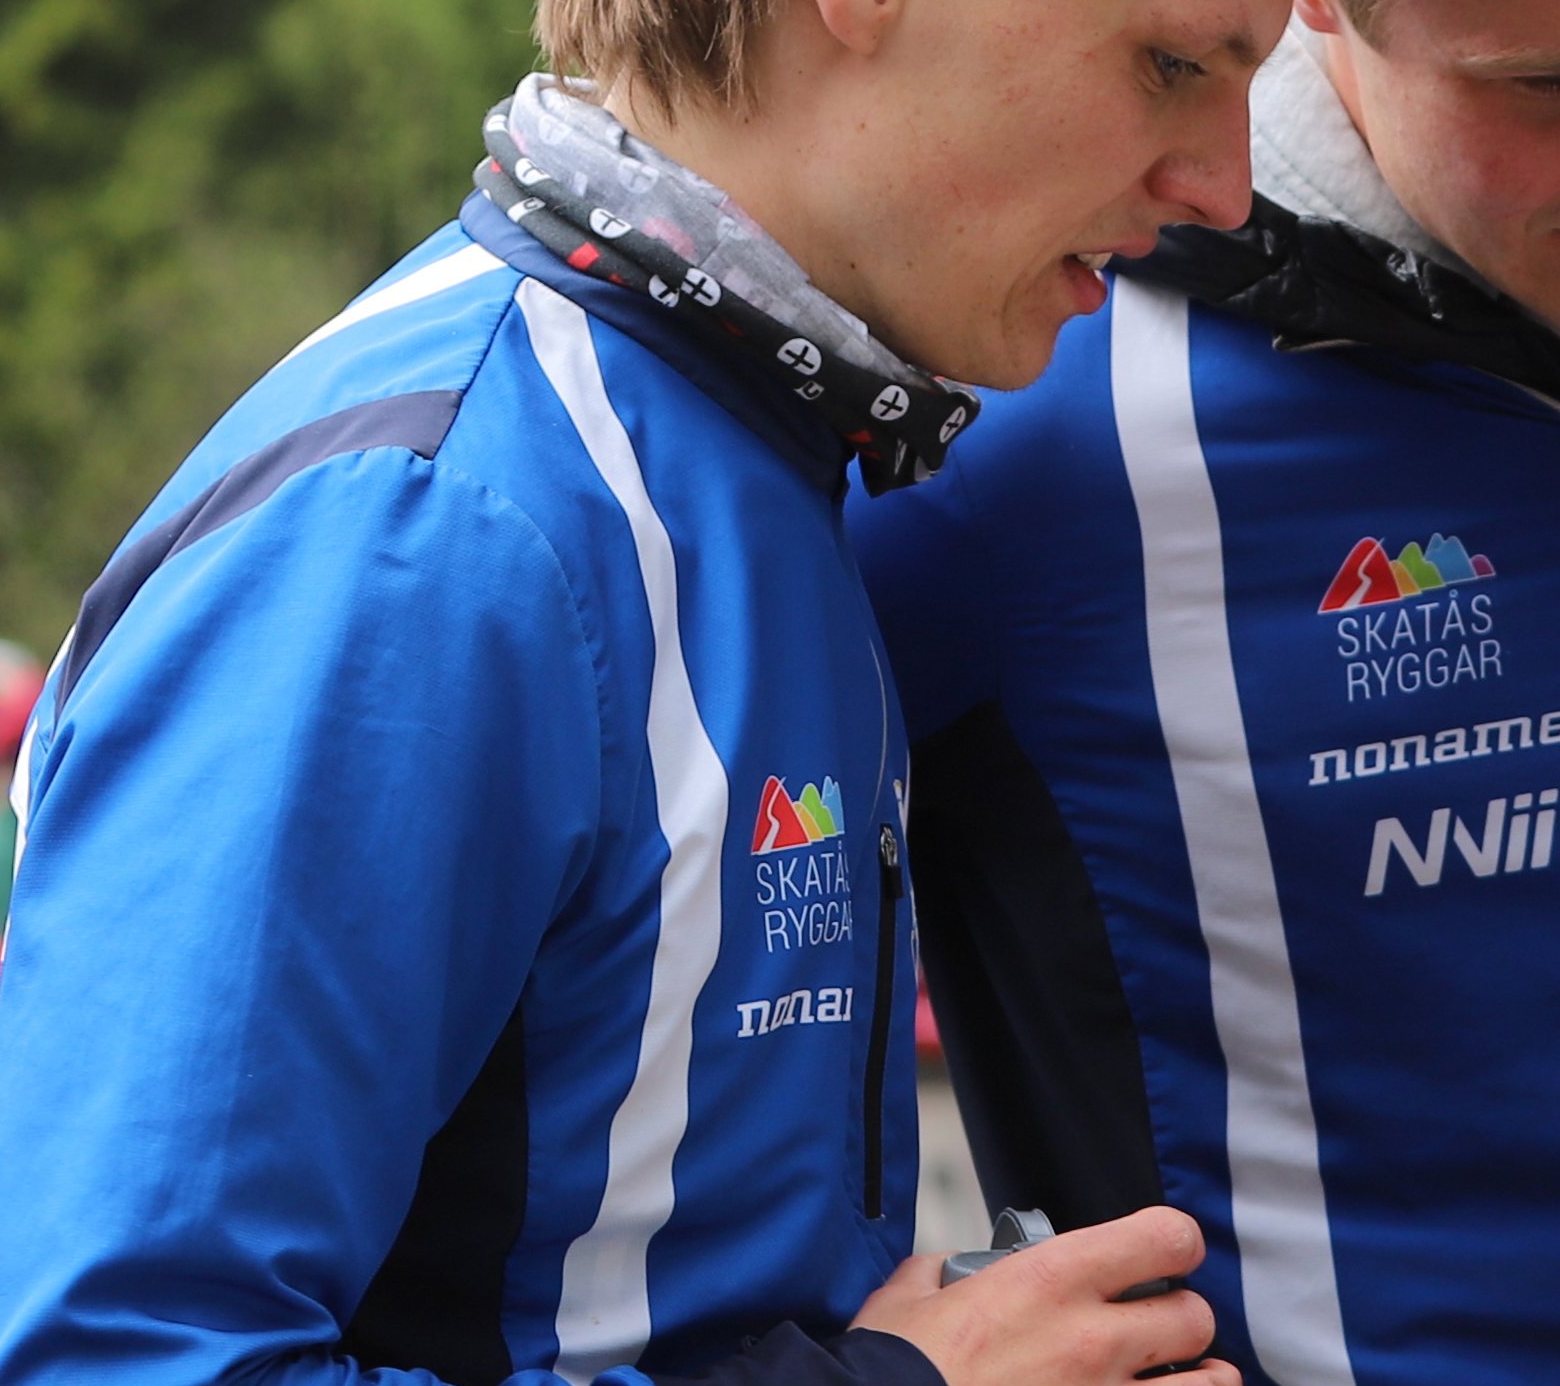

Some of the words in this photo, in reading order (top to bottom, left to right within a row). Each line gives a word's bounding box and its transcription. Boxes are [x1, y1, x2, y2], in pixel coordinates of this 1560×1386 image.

[1337, 589, 1494, 658] SKATÅS
[1346, 638, 1503, 702] RYGGAR
[764, 900, 853, 954] RYGGA
[736, 987, 853, 1038] nona
